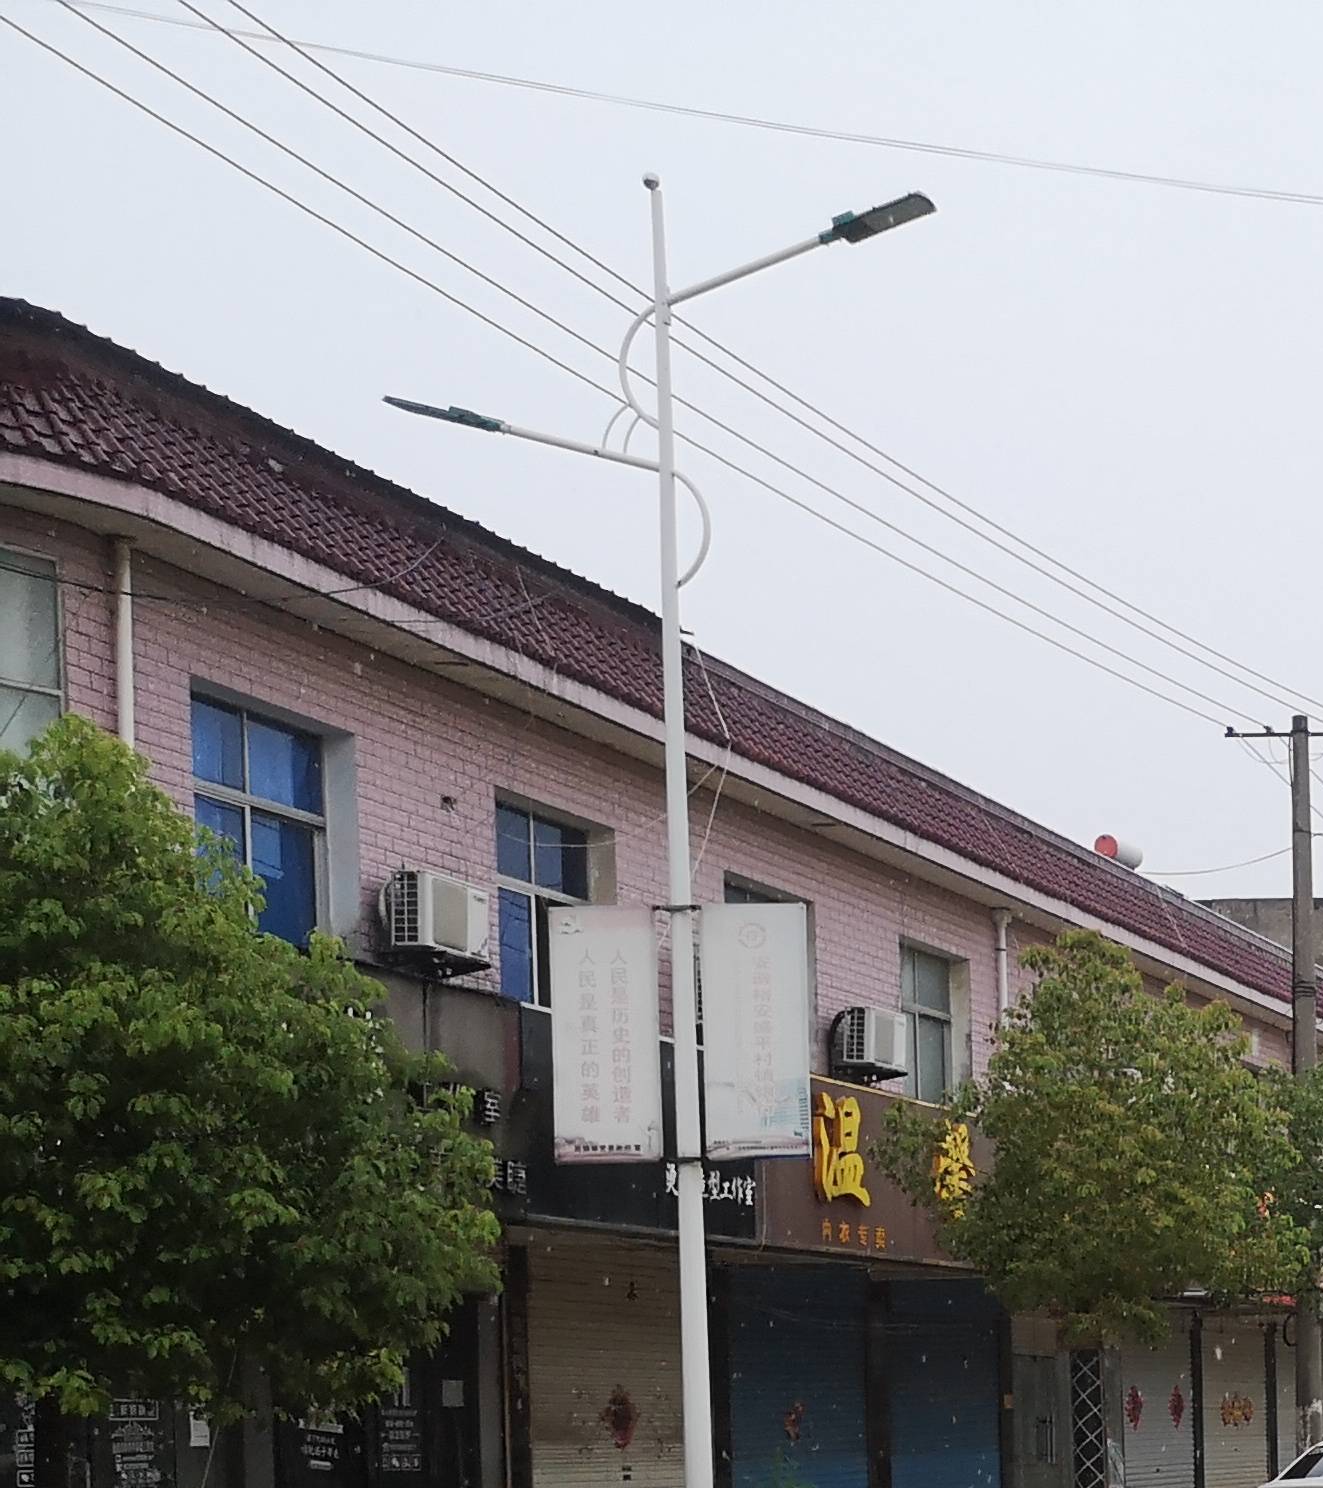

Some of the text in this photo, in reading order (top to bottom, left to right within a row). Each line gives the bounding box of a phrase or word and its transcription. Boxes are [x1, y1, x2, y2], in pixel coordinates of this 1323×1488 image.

[578, 948, 601, 1123] 人民是真正的英雄
[609, 949, 632, 1123] 人民是历史的创造者
[822, 1218, 886, 1249] 内衣专卖
